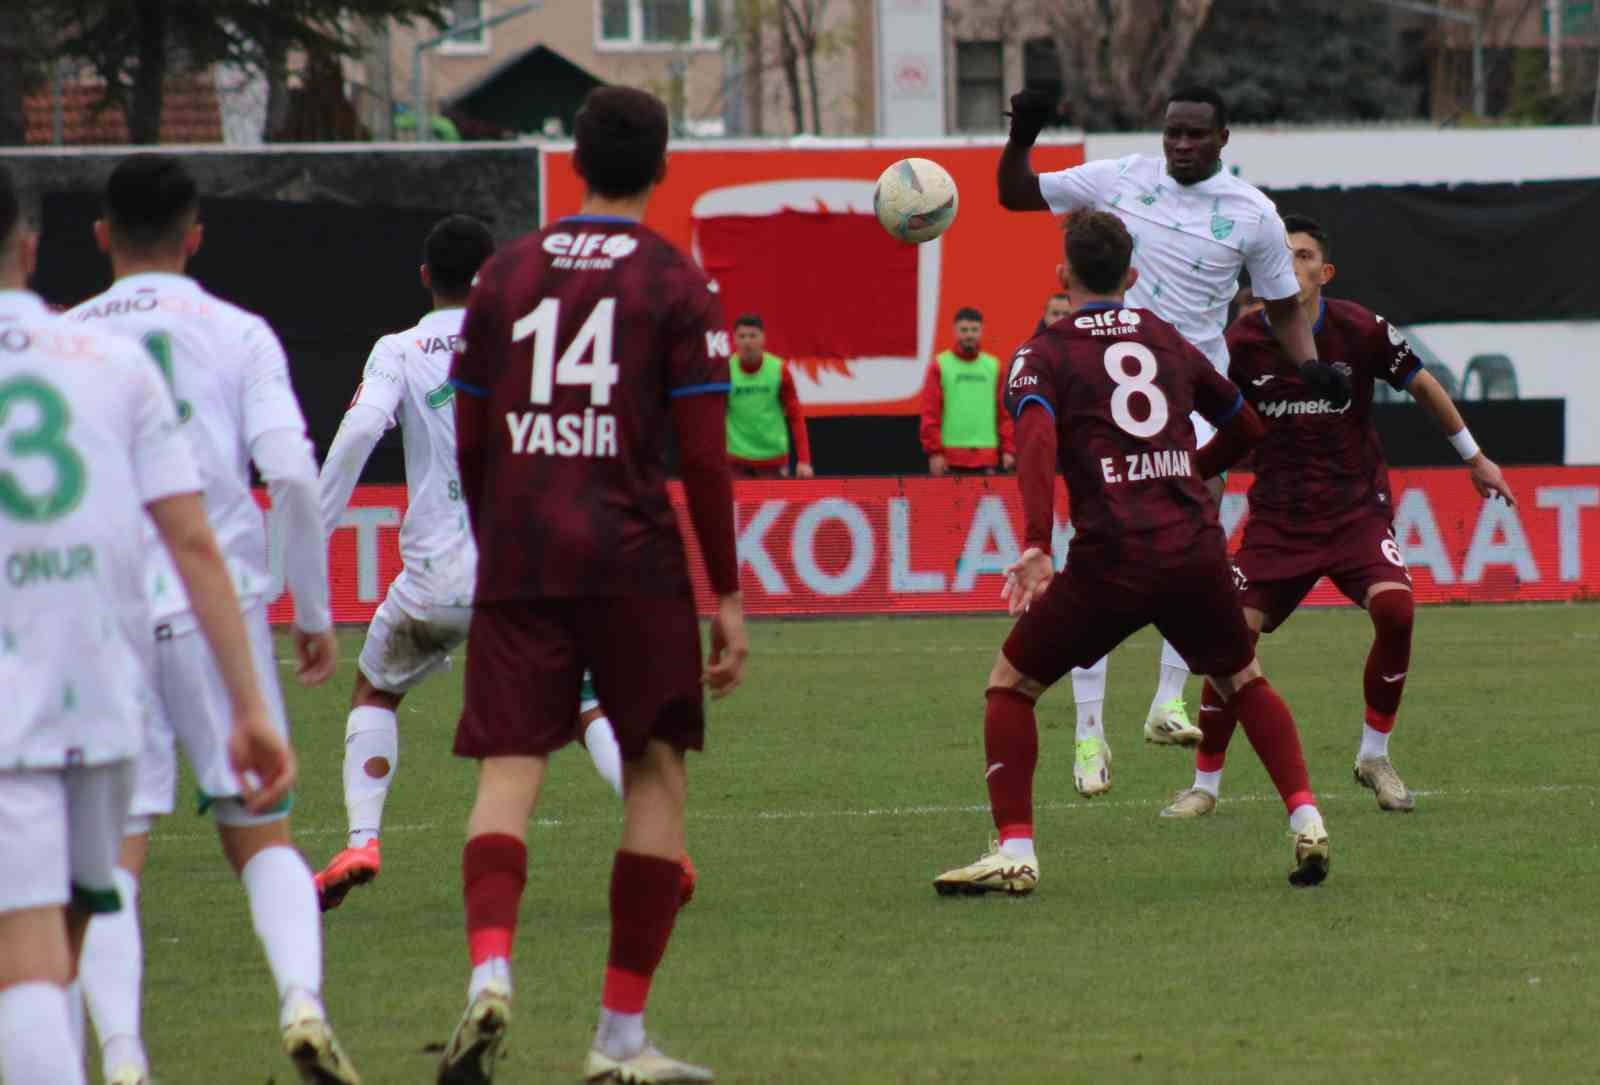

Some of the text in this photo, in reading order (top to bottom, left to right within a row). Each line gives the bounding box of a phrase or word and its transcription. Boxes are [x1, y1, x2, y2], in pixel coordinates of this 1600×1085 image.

[511, 297, 620, 406] 14
[1103, 341, 1169, 438] 8
[506, 407, 618, 456] YASİR
[1101, 451, 1192, 483] E. ZAMAN
[7, 546, 95, 587] ONUR
[1381, 538, 1404, 567] 6
